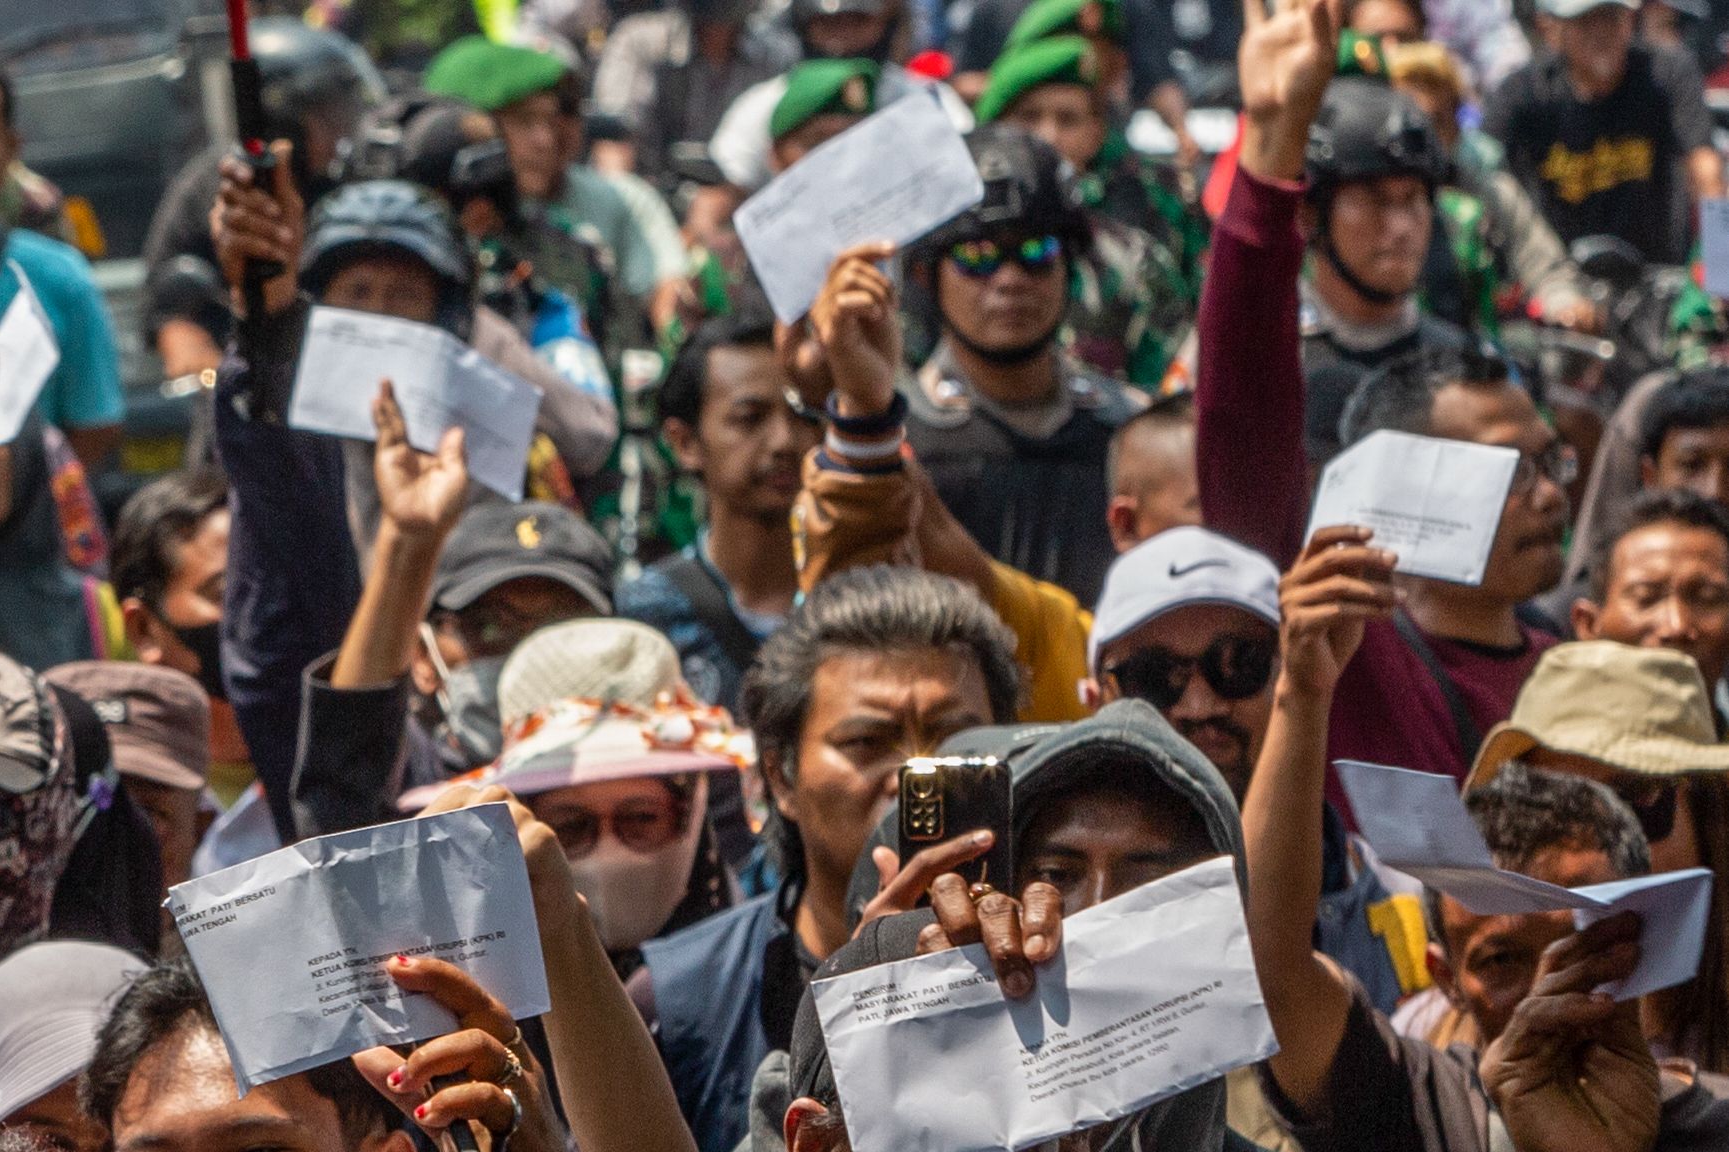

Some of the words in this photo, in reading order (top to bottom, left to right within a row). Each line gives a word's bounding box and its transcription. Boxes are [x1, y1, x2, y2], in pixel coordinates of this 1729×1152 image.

[210, 902, 231, 915] PATI
[234, 886, 276, 907] BERSATU
[201, 913, 238, 931] TENGAH
[308, 950, 342, 966] KEPADA
[311, 963, 342, 978] KETUA
[855, 990, 919, 1011] MASYARAKAT
[922, 985, 945, 995] PATI
[947, 975, 991, 990] BERSATU
[883, 1005, 910, 1018] JAWA
[912, 996, 950, 1011] TENGAH
[1022, 1050, 1050, 1066] KETUA
[1051, 1039, 1081, 1053] KOMISI
[1082, 1008, 1152, 1044] PEMBERANTASAN
[1152, 994, 1189, 1013] KORUPSI
